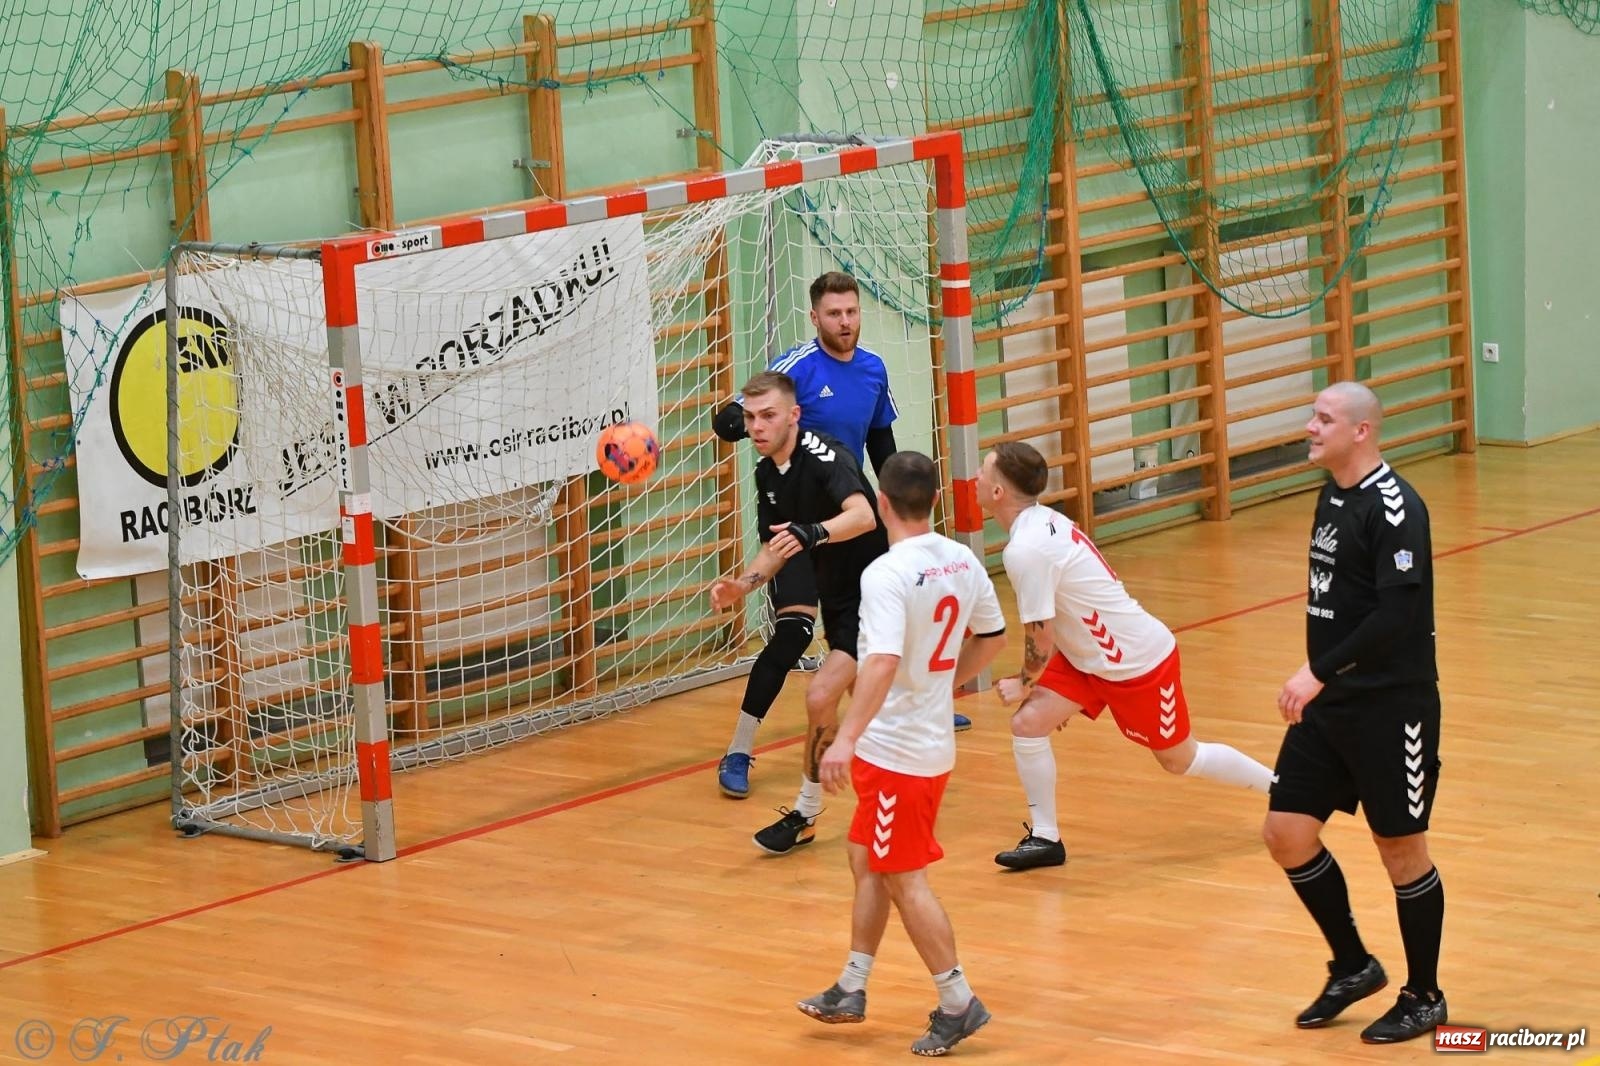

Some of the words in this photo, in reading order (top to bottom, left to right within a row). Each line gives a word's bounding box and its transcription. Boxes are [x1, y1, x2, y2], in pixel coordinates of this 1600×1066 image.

[402, 235, 428, 251] sport
[339, 432, 348, 489] sport
[120, 483, 256, 543] RACBÓRZ
[928, 595, 959, 672] 2
